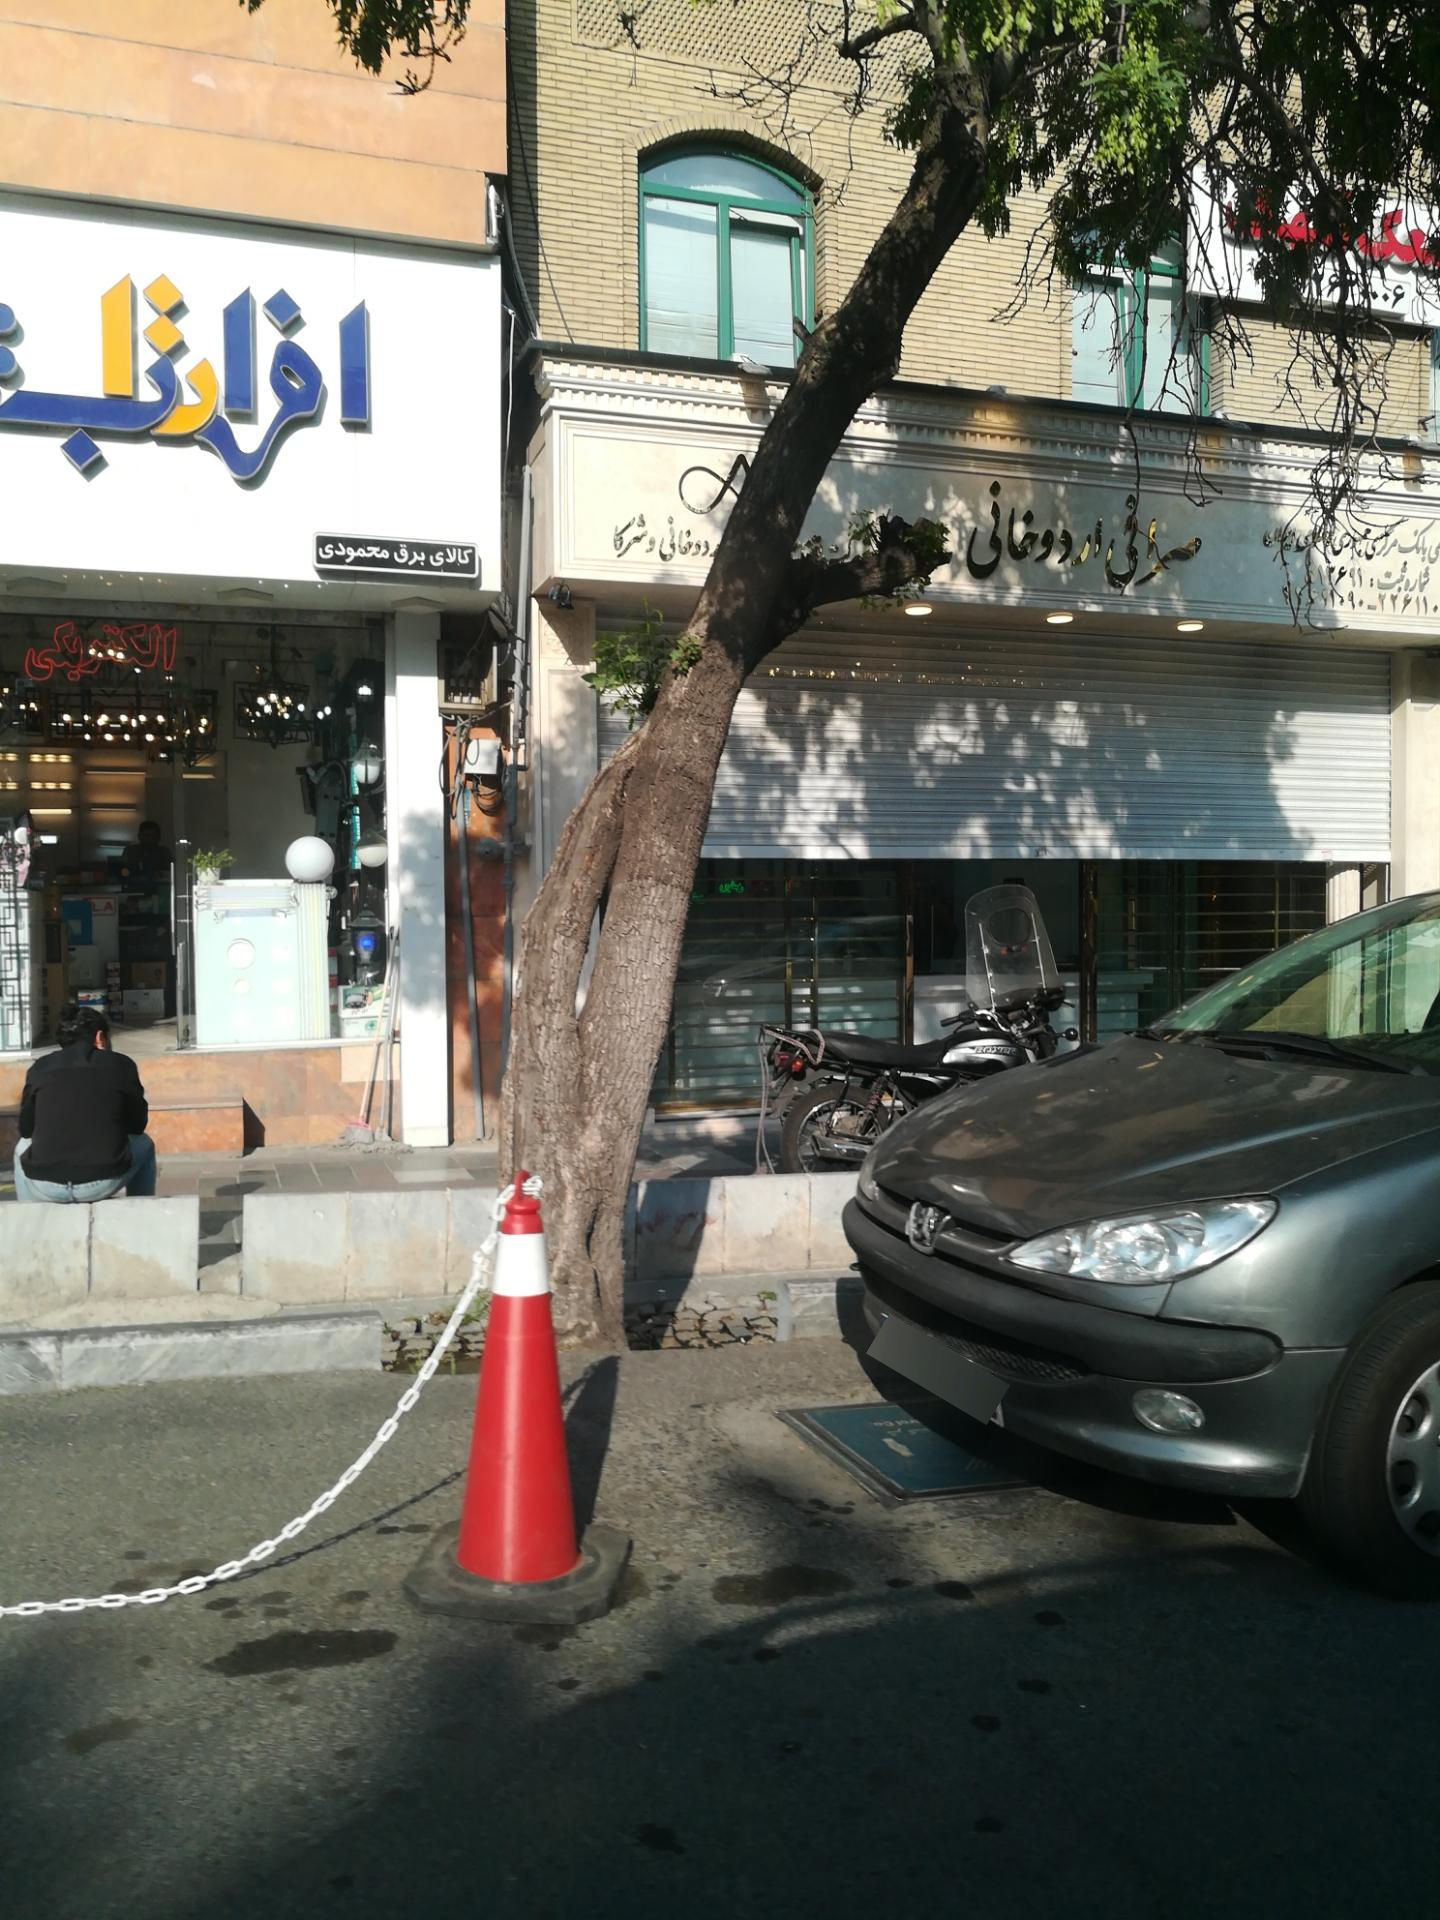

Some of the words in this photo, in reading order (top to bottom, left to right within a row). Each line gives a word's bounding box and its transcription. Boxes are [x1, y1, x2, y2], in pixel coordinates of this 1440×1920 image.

[318, 542, 390, 563] محمودی
[613, 513, 648, 558] شرکا
[966, 480, 1103, 580] اردوخانی
[1105, 494, 1202, 589] صرافی
[393, 543, 426, 566] برق
[430, 546, 473, 567] کالای
[24, 620, 177, 681] الکتریکی
